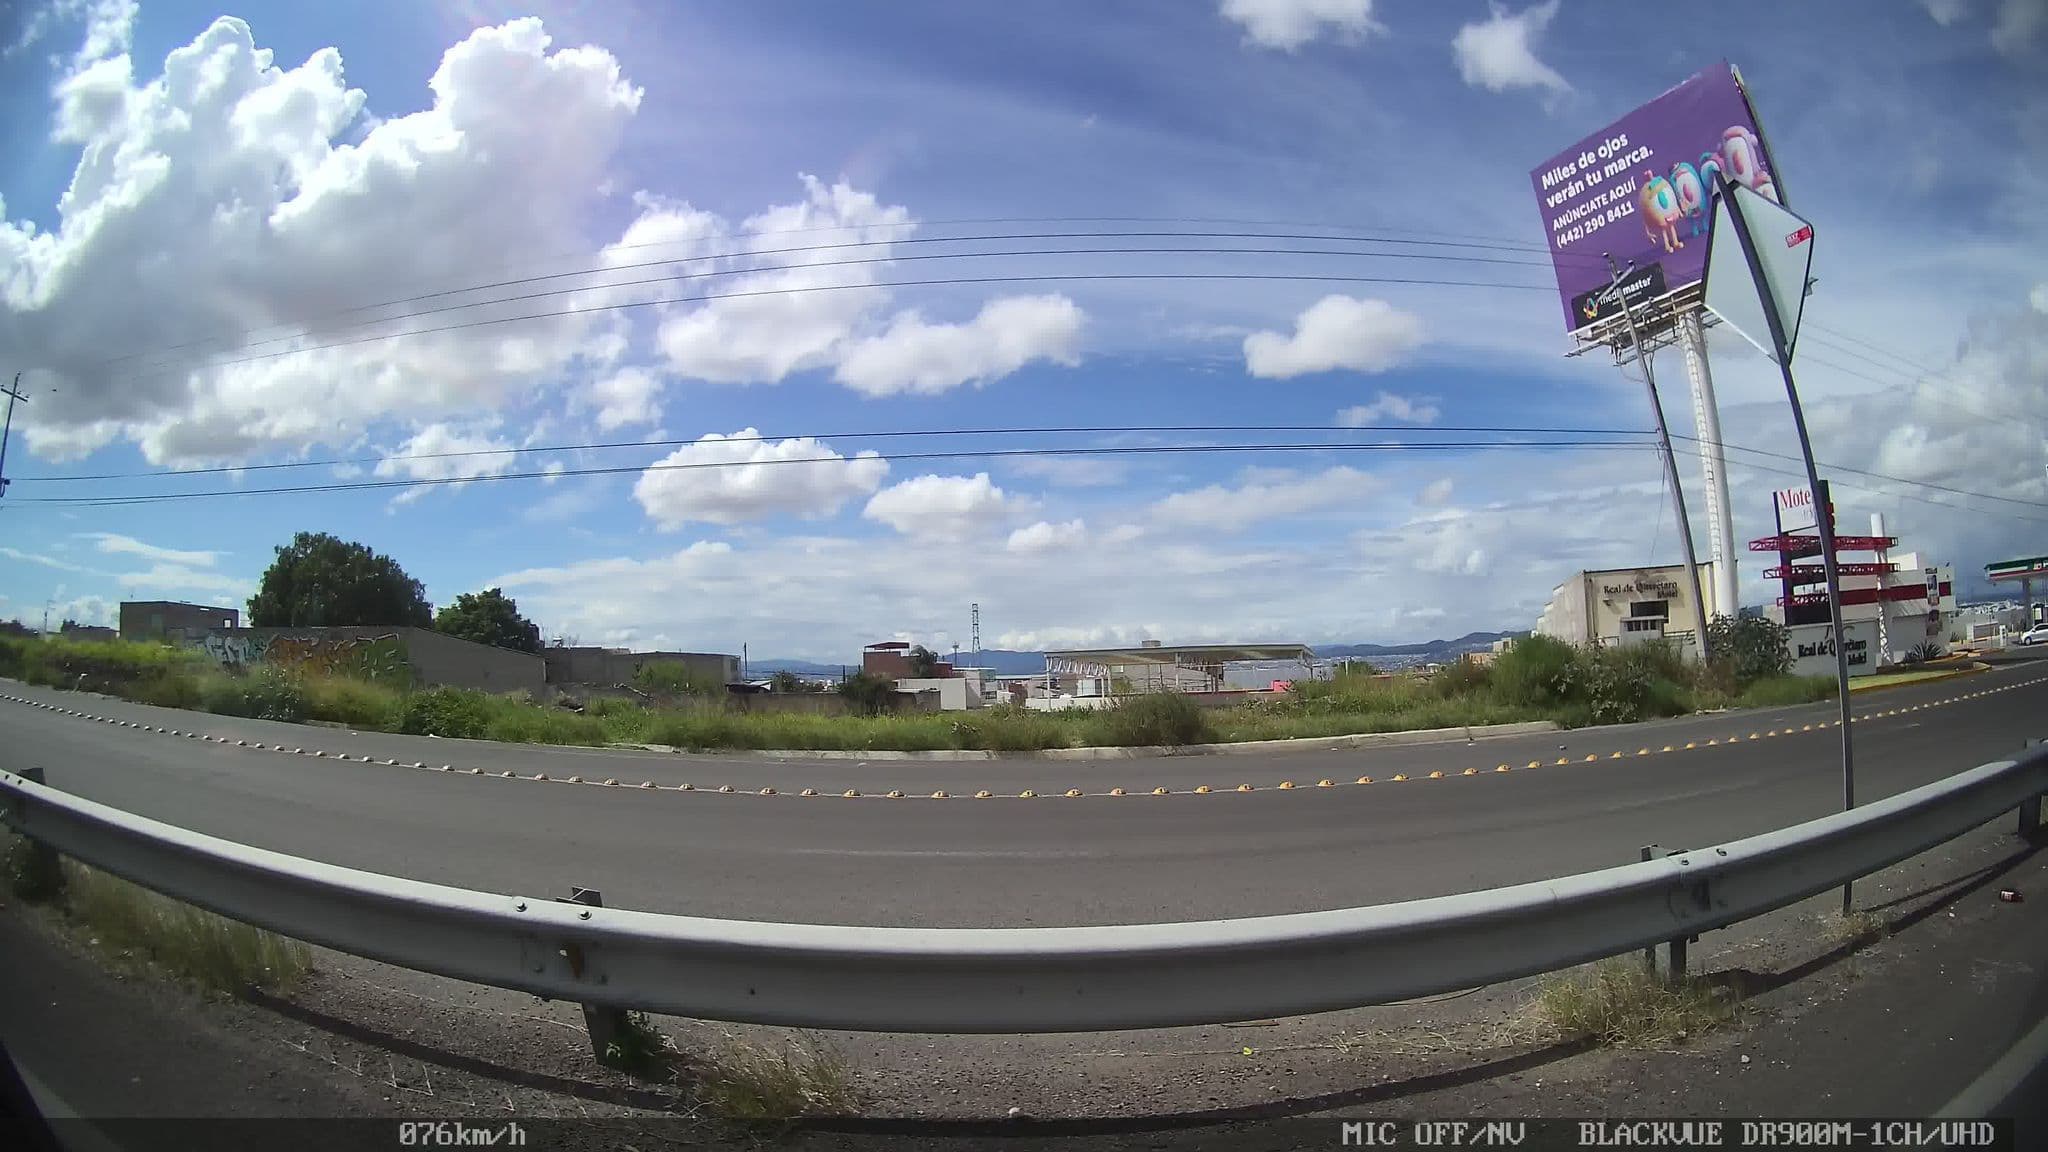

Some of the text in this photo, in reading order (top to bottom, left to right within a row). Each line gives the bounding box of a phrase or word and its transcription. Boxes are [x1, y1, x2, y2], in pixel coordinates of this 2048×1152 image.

[1541, 134, 1628, 190] Miles de ojos
[1546, 145, 1654, 208] verán tu marca.
[1609, 176, 1637, 202] AQUÍ
[1556, 201, 1635, 248] (442) 290 8411
[1603, 584, 1621, 594] Real
[1623, 583, 1634, 593] de
[1798, 642, 1816, 658] Real
[1817, 641, 1828, 656] de
